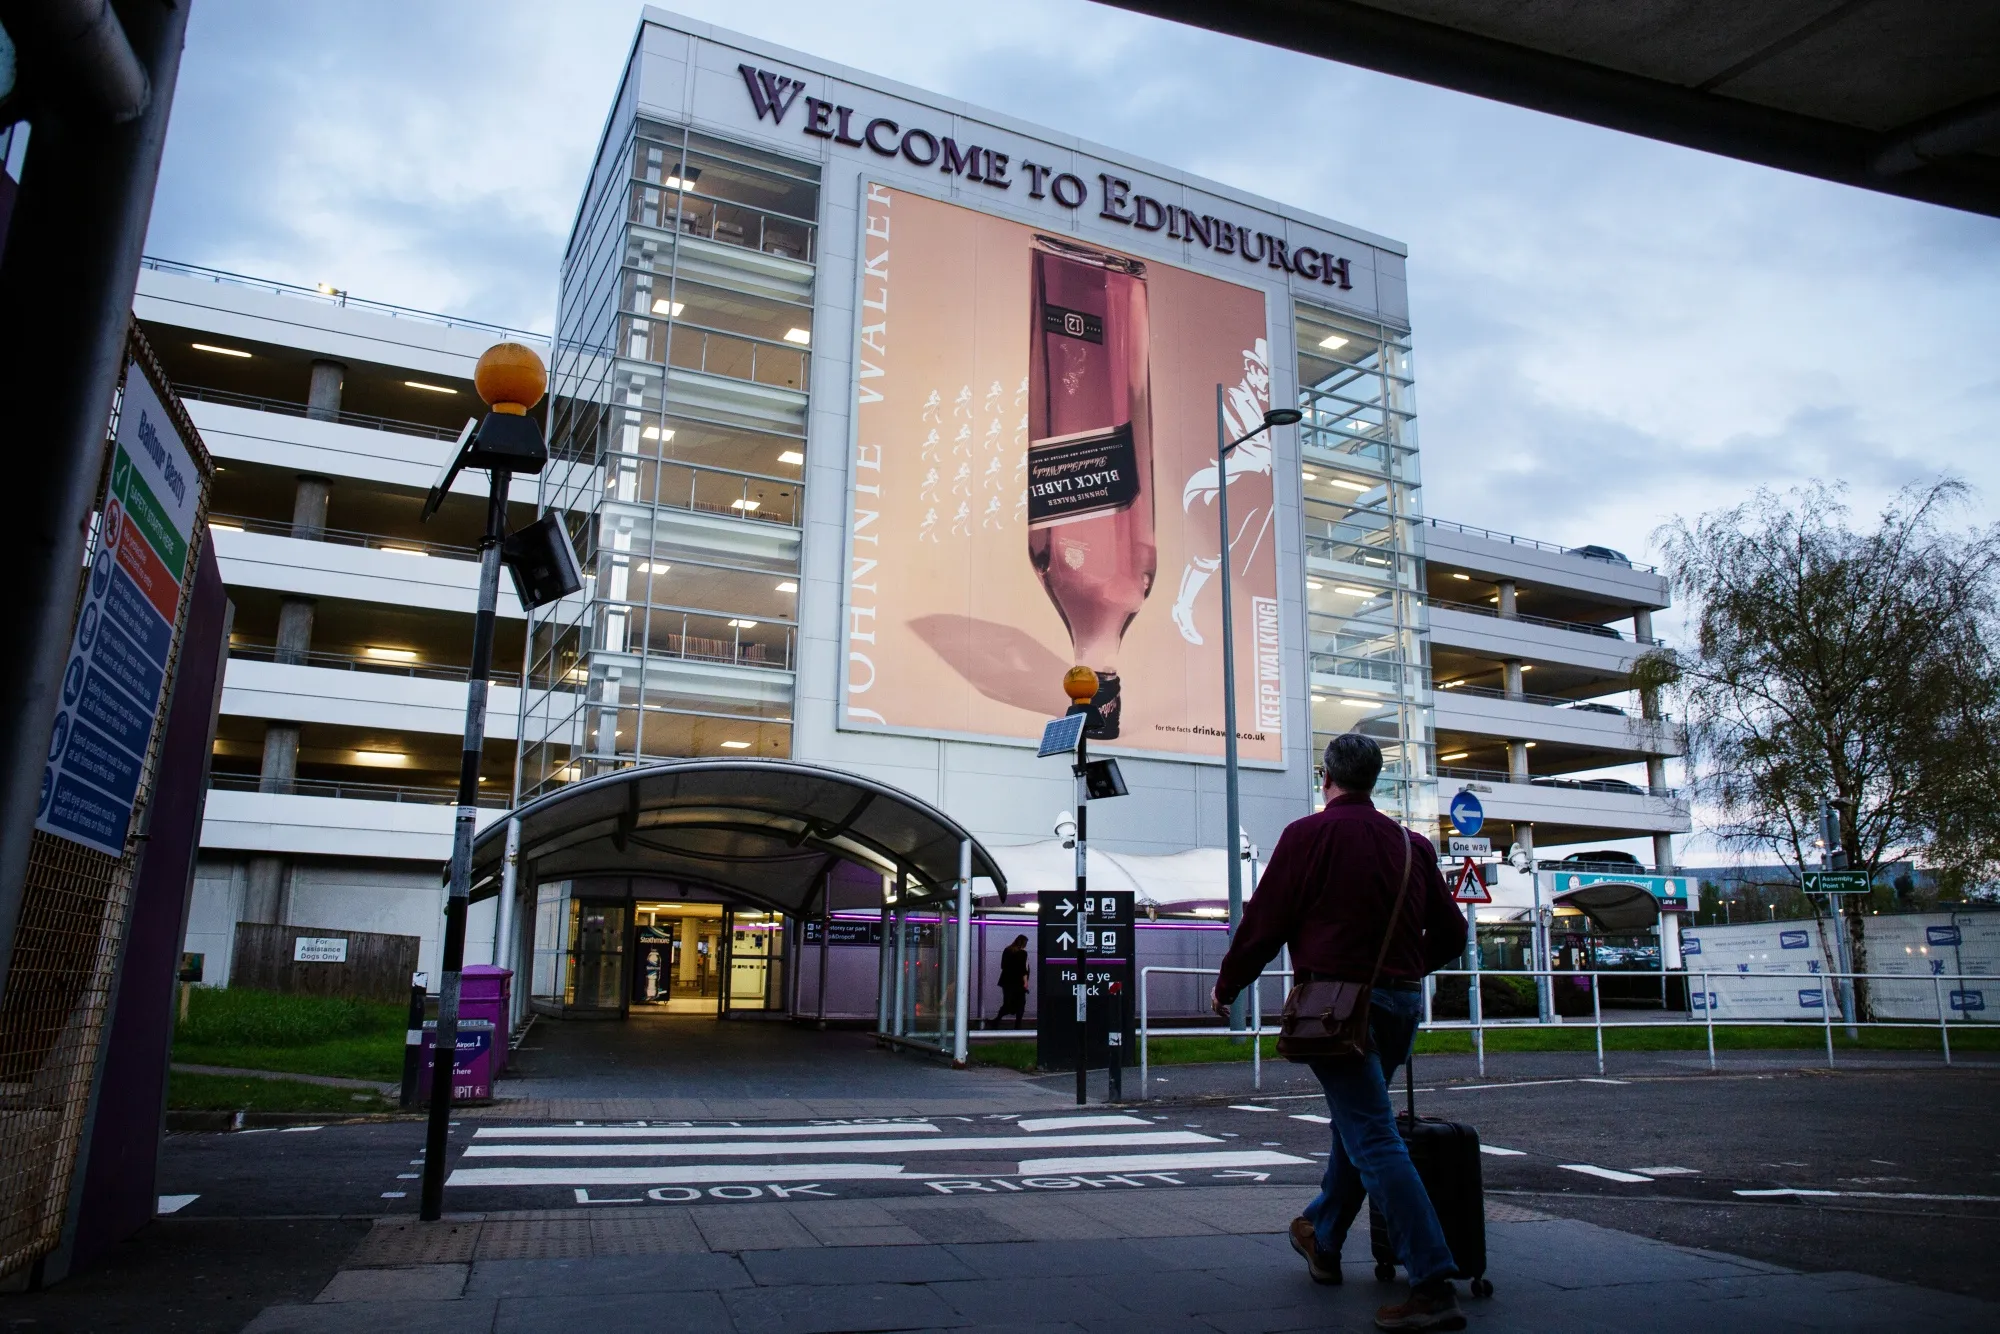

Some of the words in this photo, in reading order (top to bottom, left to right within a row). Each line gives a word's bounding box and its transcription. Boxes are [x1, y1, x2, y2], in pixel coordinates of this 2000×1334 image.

[738, 63, 1012, 189] WELCOME
[1022, 158, 1087, 208] TO
[1099, 172, 1353, 290] EDINBURGH
[1068, 317, 1080, 332] 12
[138, 410, 164, 470] Balfour
[163, 451, 185, 510] Beatty
[1029, 478, 1073, 498] LABEL
[1074, 470, 1121, 489] BLACK
[1047, 495, 1078, 506] WALKER
[1076, 486, 1109, 502] JOHNNIE
[848, 445, 886, 726] JOHNNIE
[1258, 602, 1280, 680] WALKING
[1260, 684, 1281, 726] KEEP
[1155, 724, 1164, 732] for
[1192, 726, 1266, 741] drinkawe.co.uk
[1452, 842, 1470, 851] One
[1472, 844, 1488, 852] way
[640, 936, 670, 944] Strathmore
[300, 952, 320, 960] Dogs
[1062, 970, 1094, 980] Hae
[1097, 972, 1110, 984] ye
[1072, 984, 1100, 996] bck
[574, 1183, 838, 1204] LOOK
[924, 1172, 1186, 1194] RIGHT
